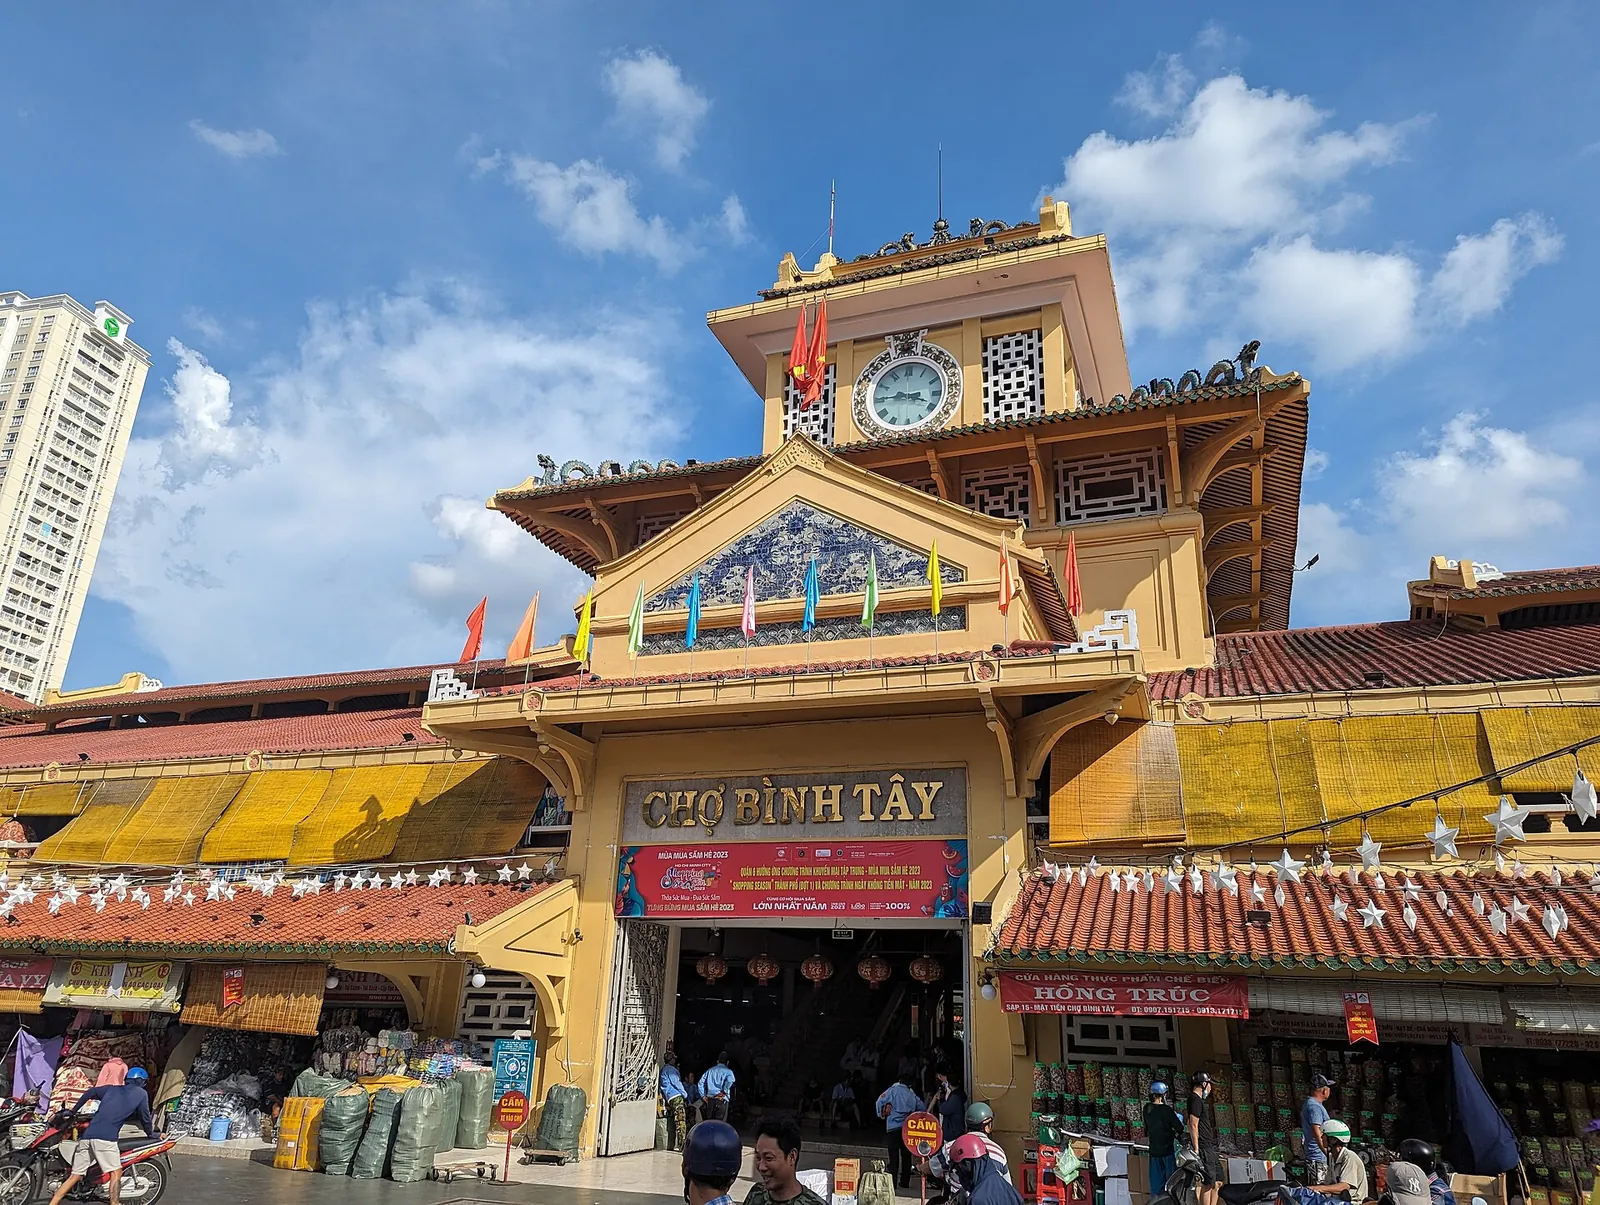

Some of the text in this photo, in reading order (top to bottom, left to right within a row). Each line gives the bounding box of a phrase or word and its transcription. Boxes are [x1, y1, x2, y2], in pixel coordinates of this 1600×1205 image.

[642, 772, 944, 836] CHỢ BÌNH TÂY
[908, 866, 920, 875] 2023
[921, 880, 932, 890] 2023
[753, 901, 773, 910] LỚN
[774, 901, 801, 910] NHẤT
[803, 901, 827, 910] NĂM
[885, 902, 910, 910] 100%
[21, 975, 46, 985] VY
[1015, 973, 1040, 981] CỬA
[1044, 973, 1078, 981] HÀNG
[1122, 974, 1162, 982] PHẨM
[1164, 975, 1193, 983] CHẾ
[1034, 982, 1210, 1002] HỒNG TRÚC
[1006, 1004, 1020, 1012] SẠP
[1034, 1004, 1048, 1012] MẶT
[1050, 1003, 1066, 1011] TIỀN
[1083, 1004, 1100, 1012] BÌNH
[502, 1095, 524, 1106] CẤM
[908, 1118, 936, 1130] CẤM
